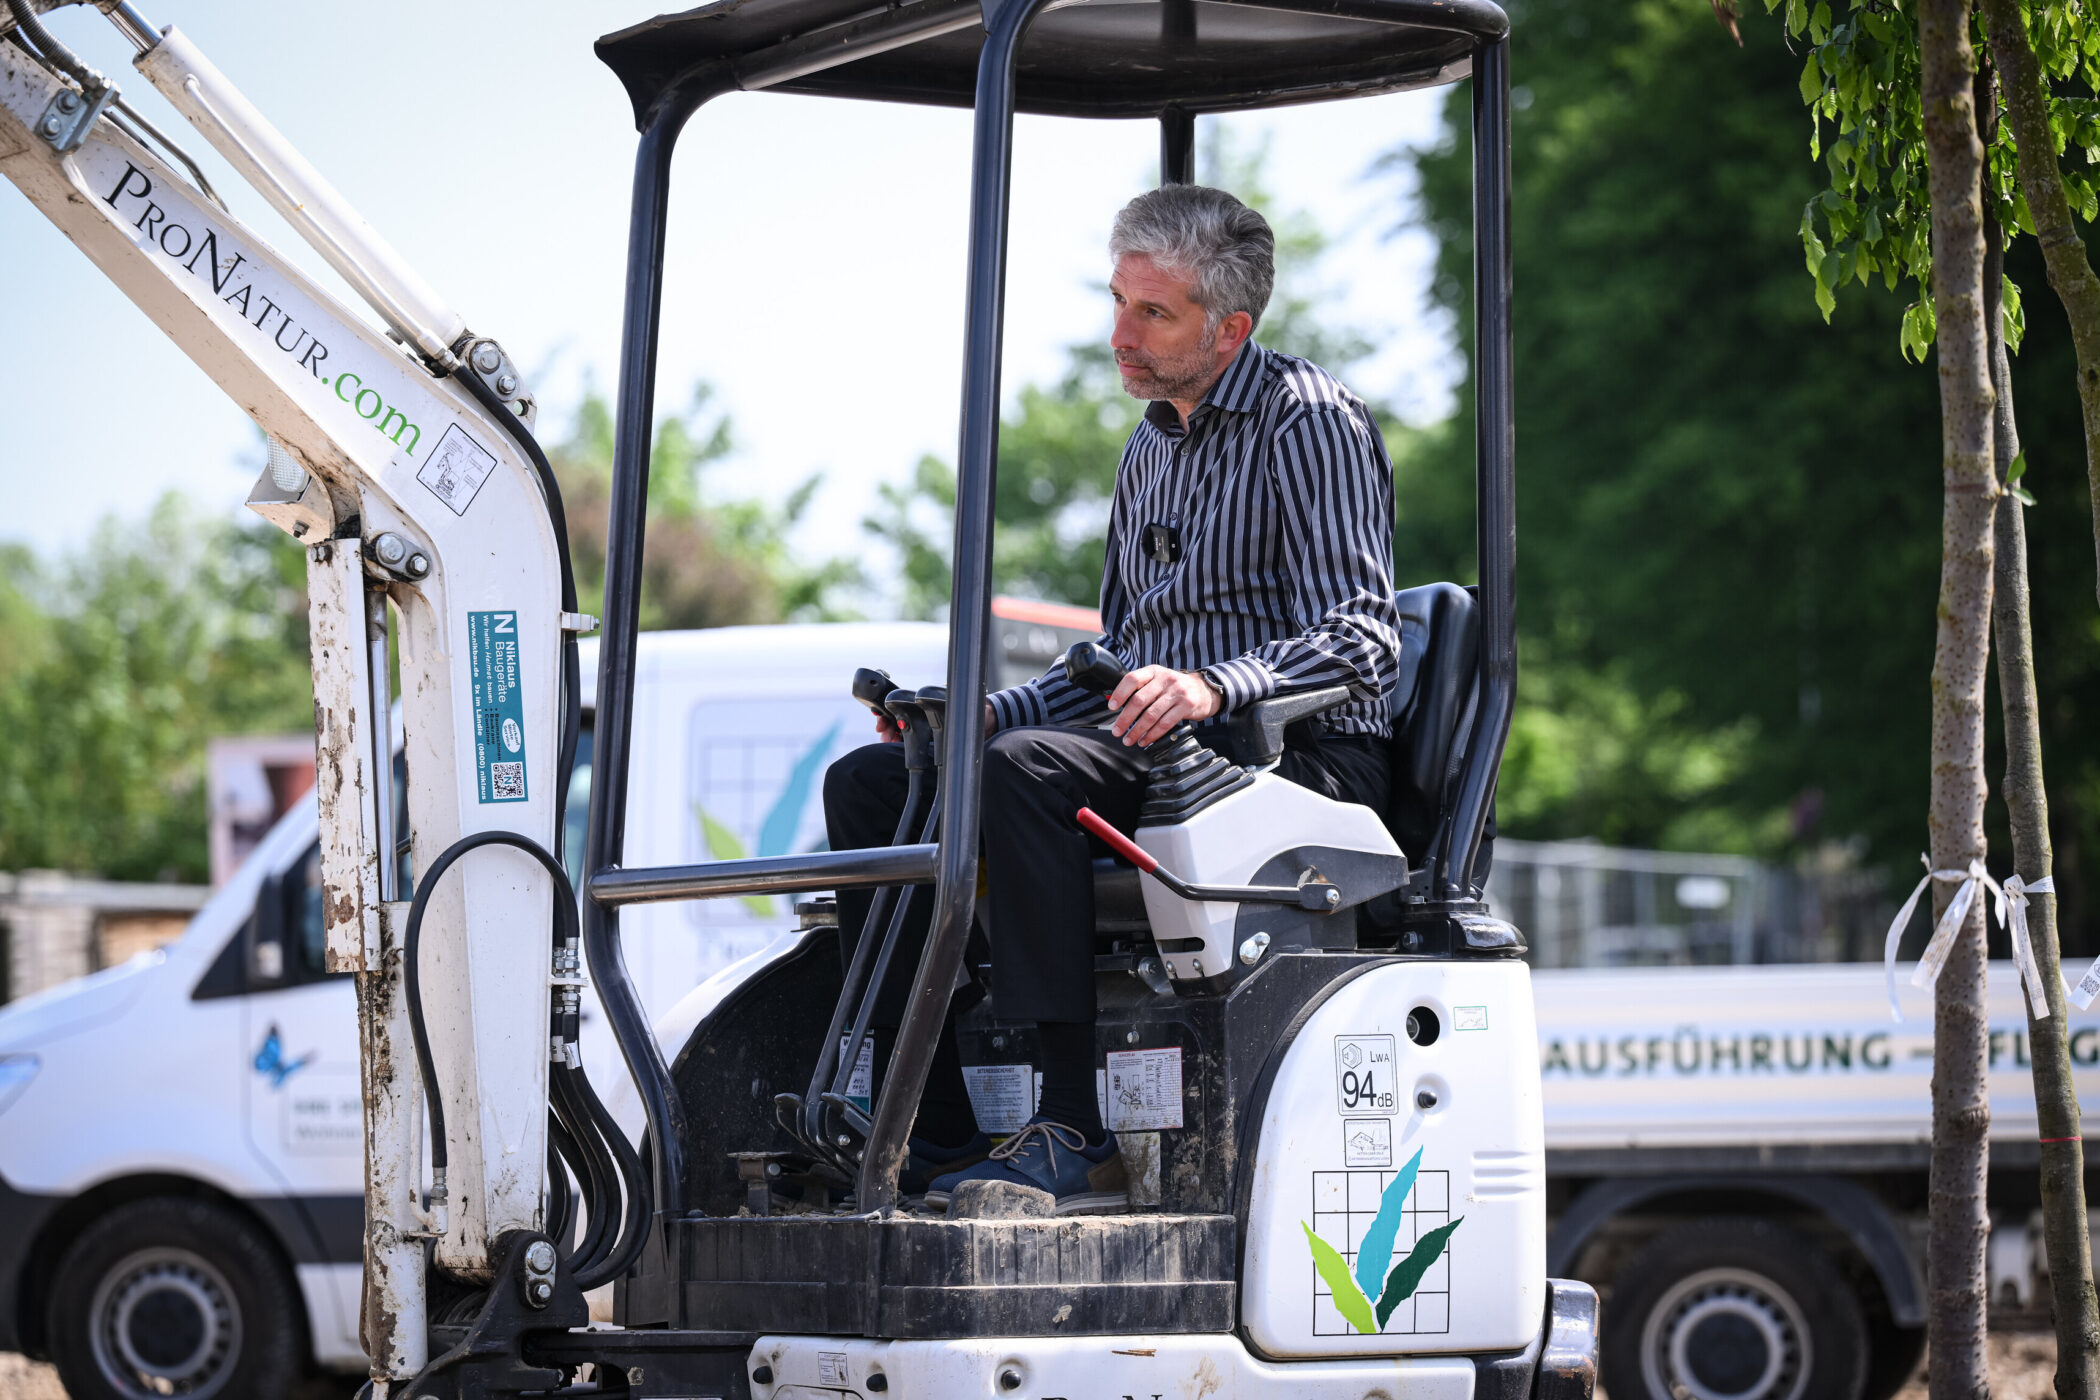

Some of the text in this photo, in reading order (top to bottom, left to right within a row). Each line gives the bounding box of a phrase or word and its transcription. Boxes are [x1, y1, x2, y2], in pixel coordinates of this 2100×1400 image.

[494, 614, 514, 633] N
[471, 616, 479, 677] www.nikbau.de
[475, 697, 481, 706] im
[495, 642, 507, 702] Baugeräte
[506, 642, 516, 688] Niklaus
[1543, 1023, 1893, 1076] AUSFÜHRUNG
